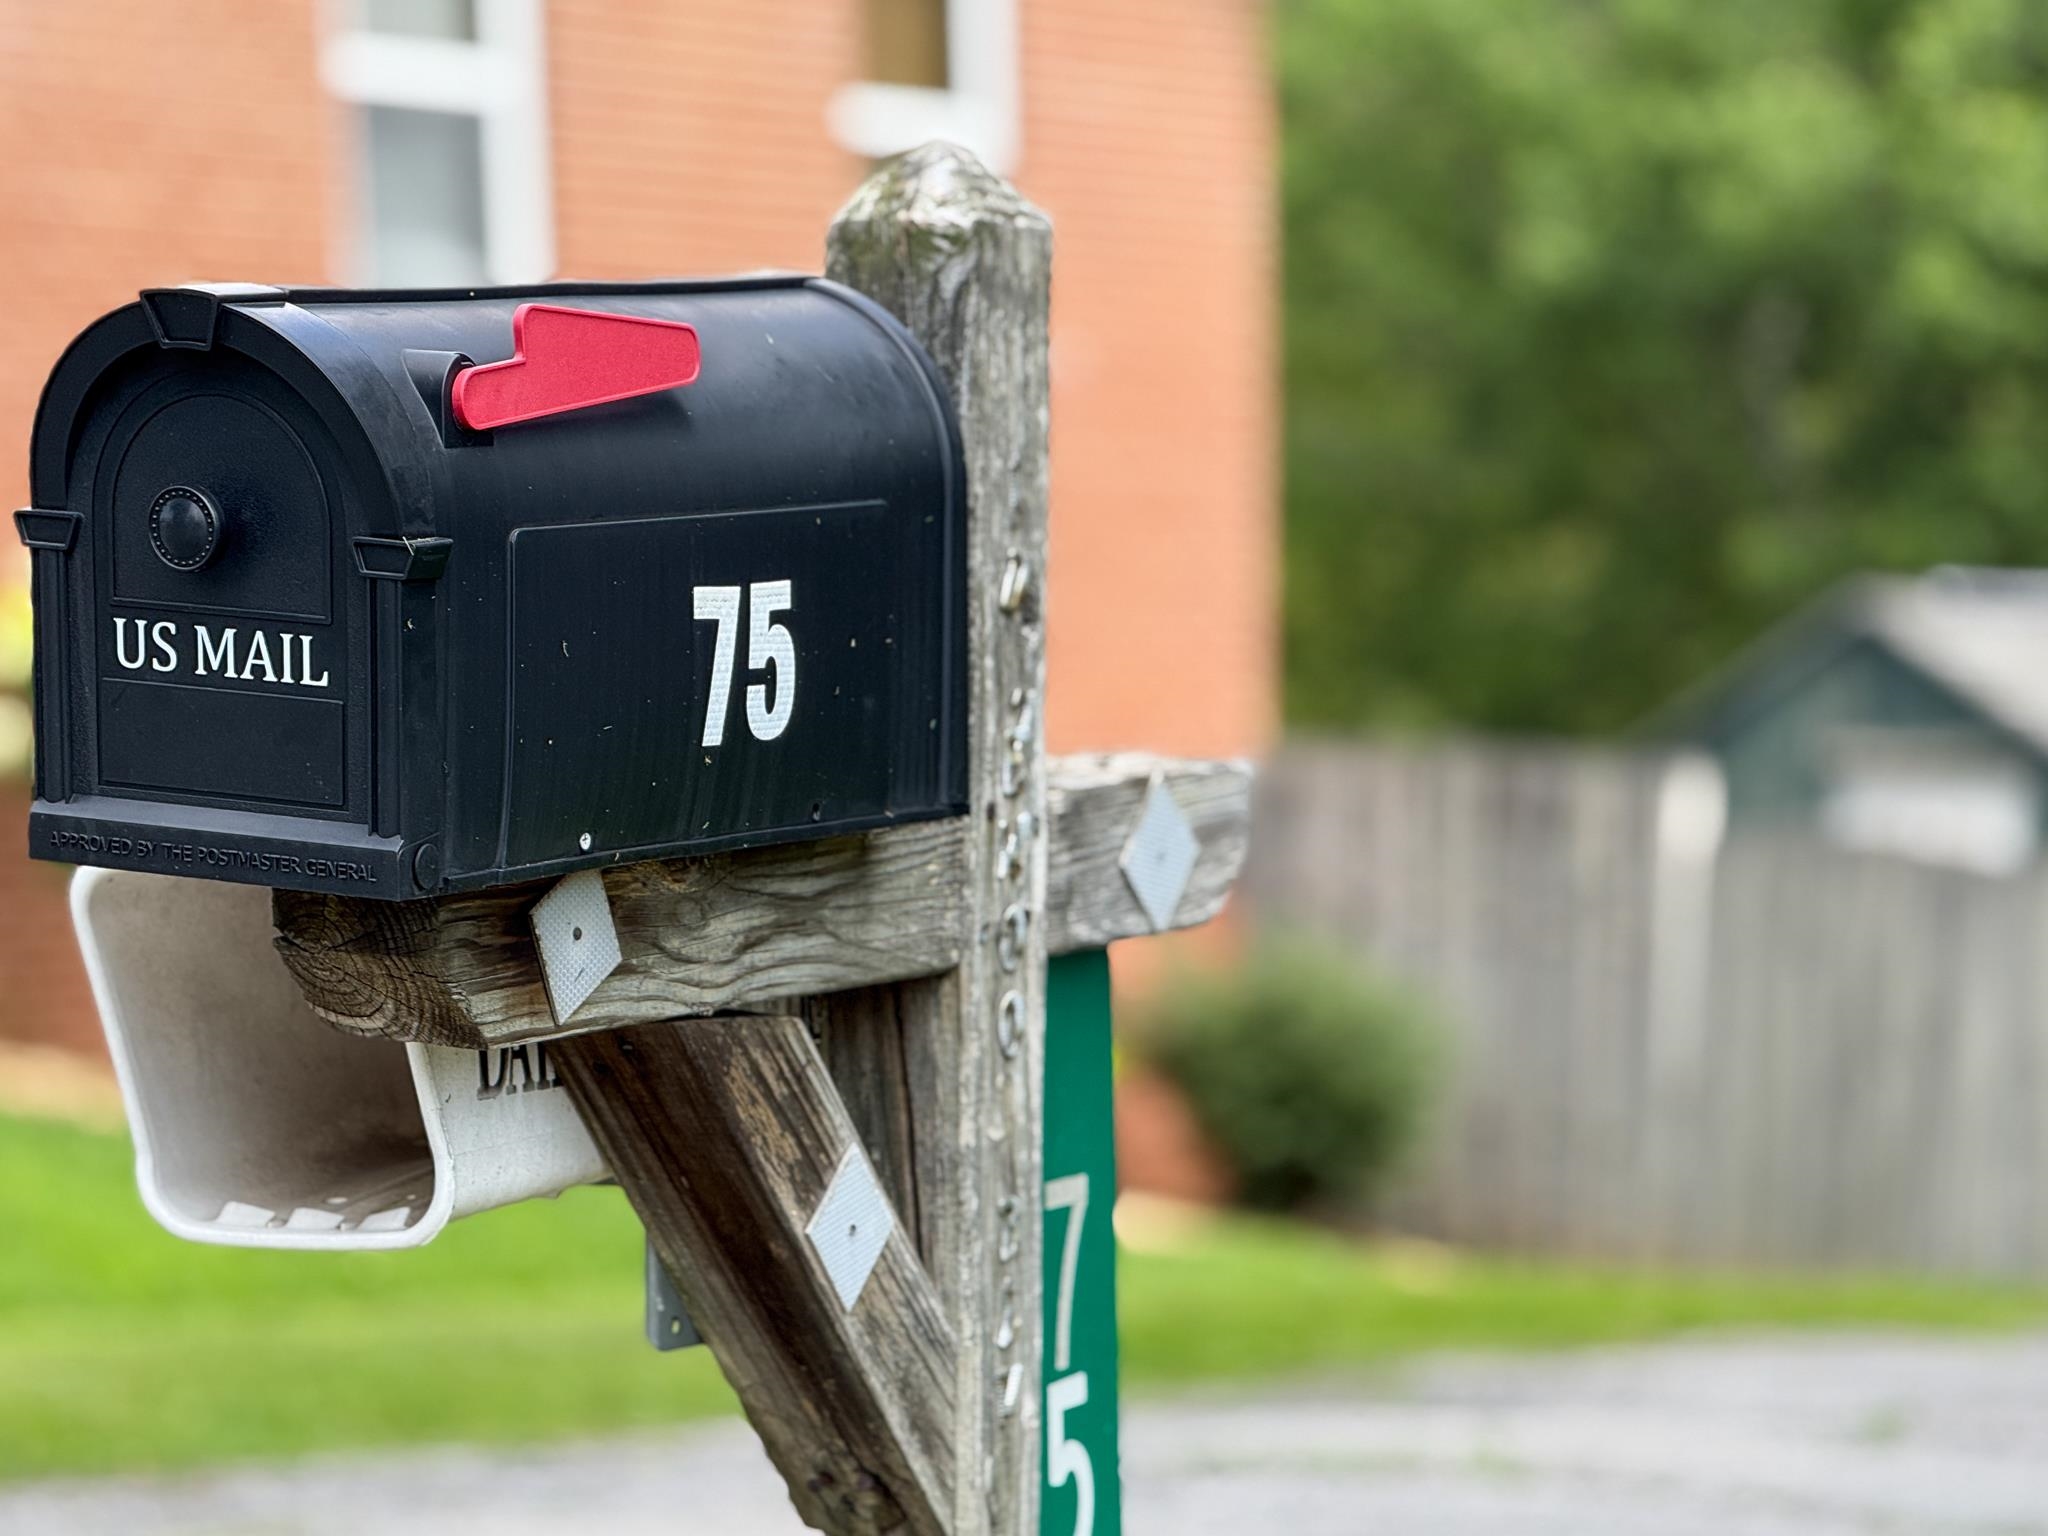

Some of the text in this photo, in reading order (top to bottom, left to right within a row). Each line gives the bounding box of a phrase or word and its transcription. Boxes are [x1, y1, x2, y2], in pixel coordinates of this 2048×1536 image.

[113, 617, 329, 687] US MAIL
[693, 579, 796, 747] 75
[50, 831, 377, 882] APPROVED BY THE POSTMASTER GENERAL
